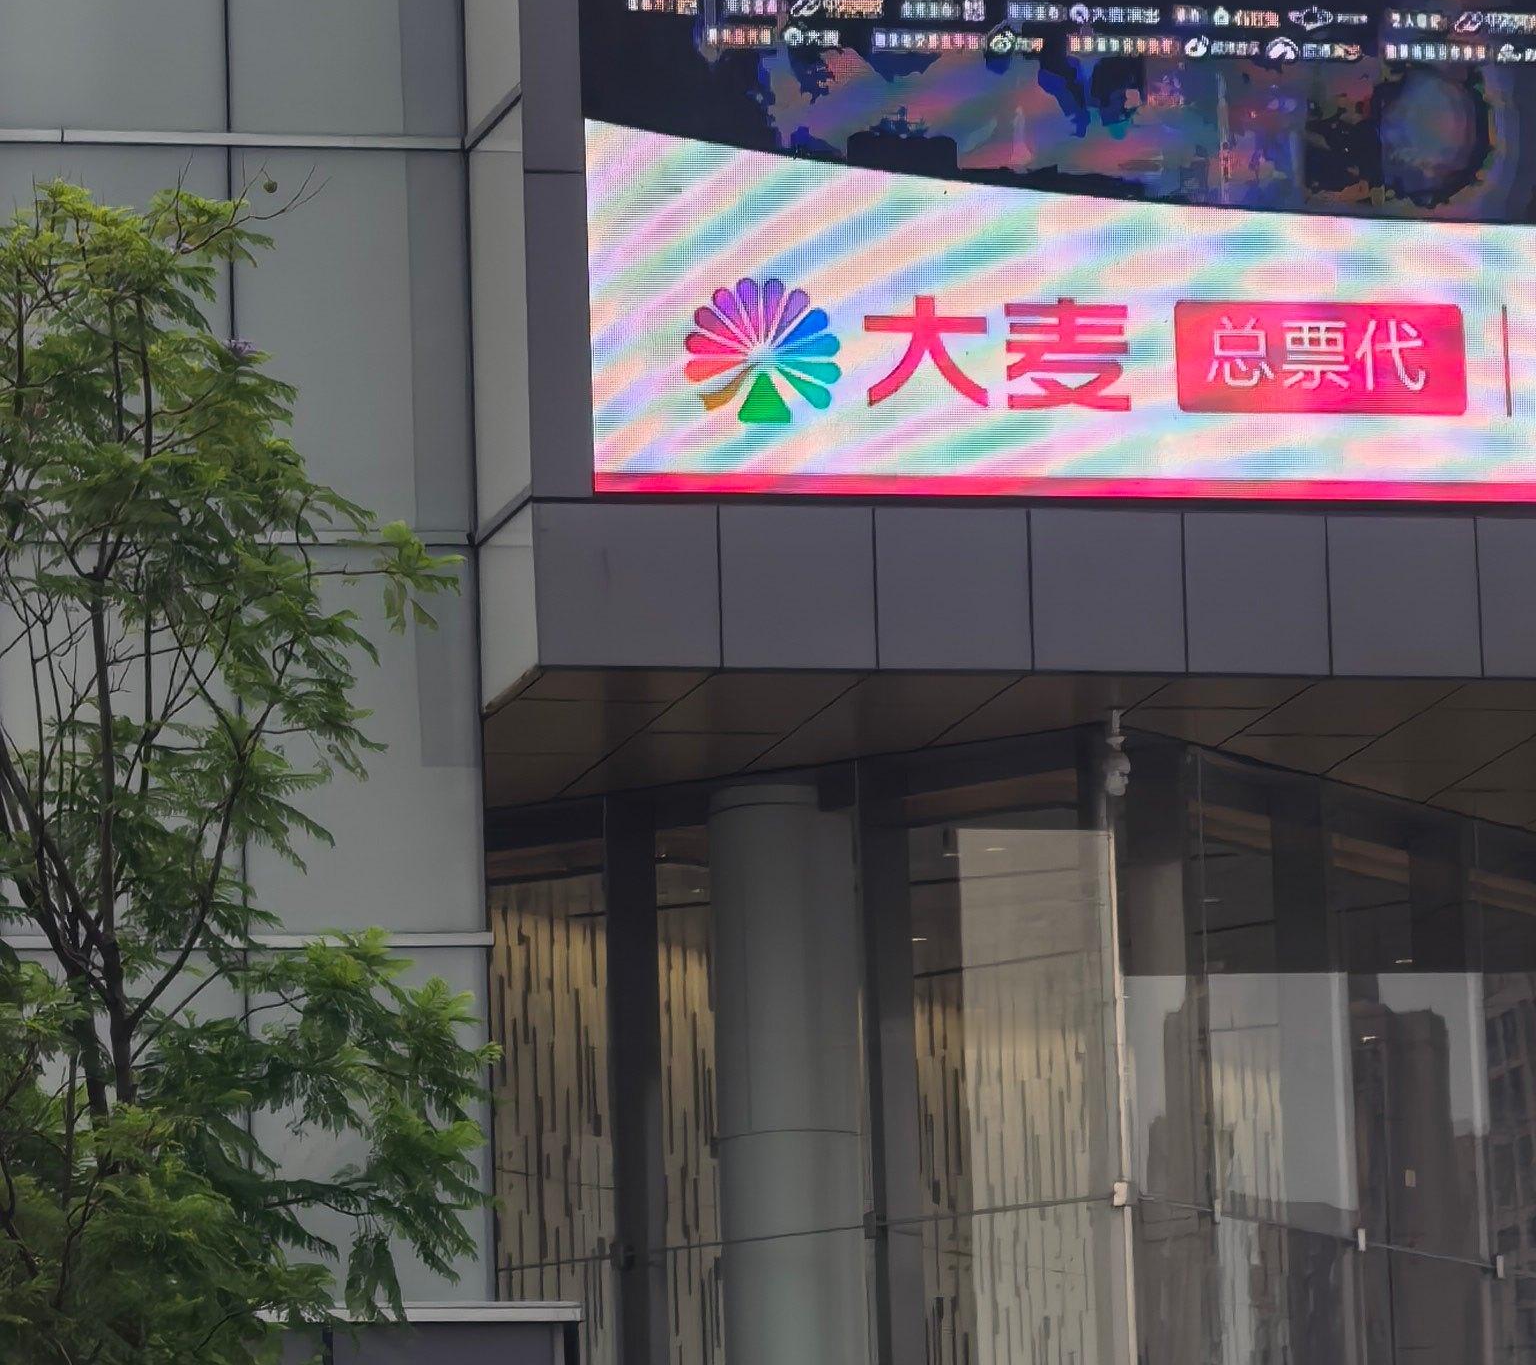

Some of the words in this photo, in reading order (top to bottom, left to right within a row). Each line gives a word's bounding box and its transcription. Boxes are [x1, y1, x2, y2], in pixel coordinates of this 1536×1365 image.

[863, 294, 1132, 411] 大麦
[1206, 314, 1427, 393] 总票代
